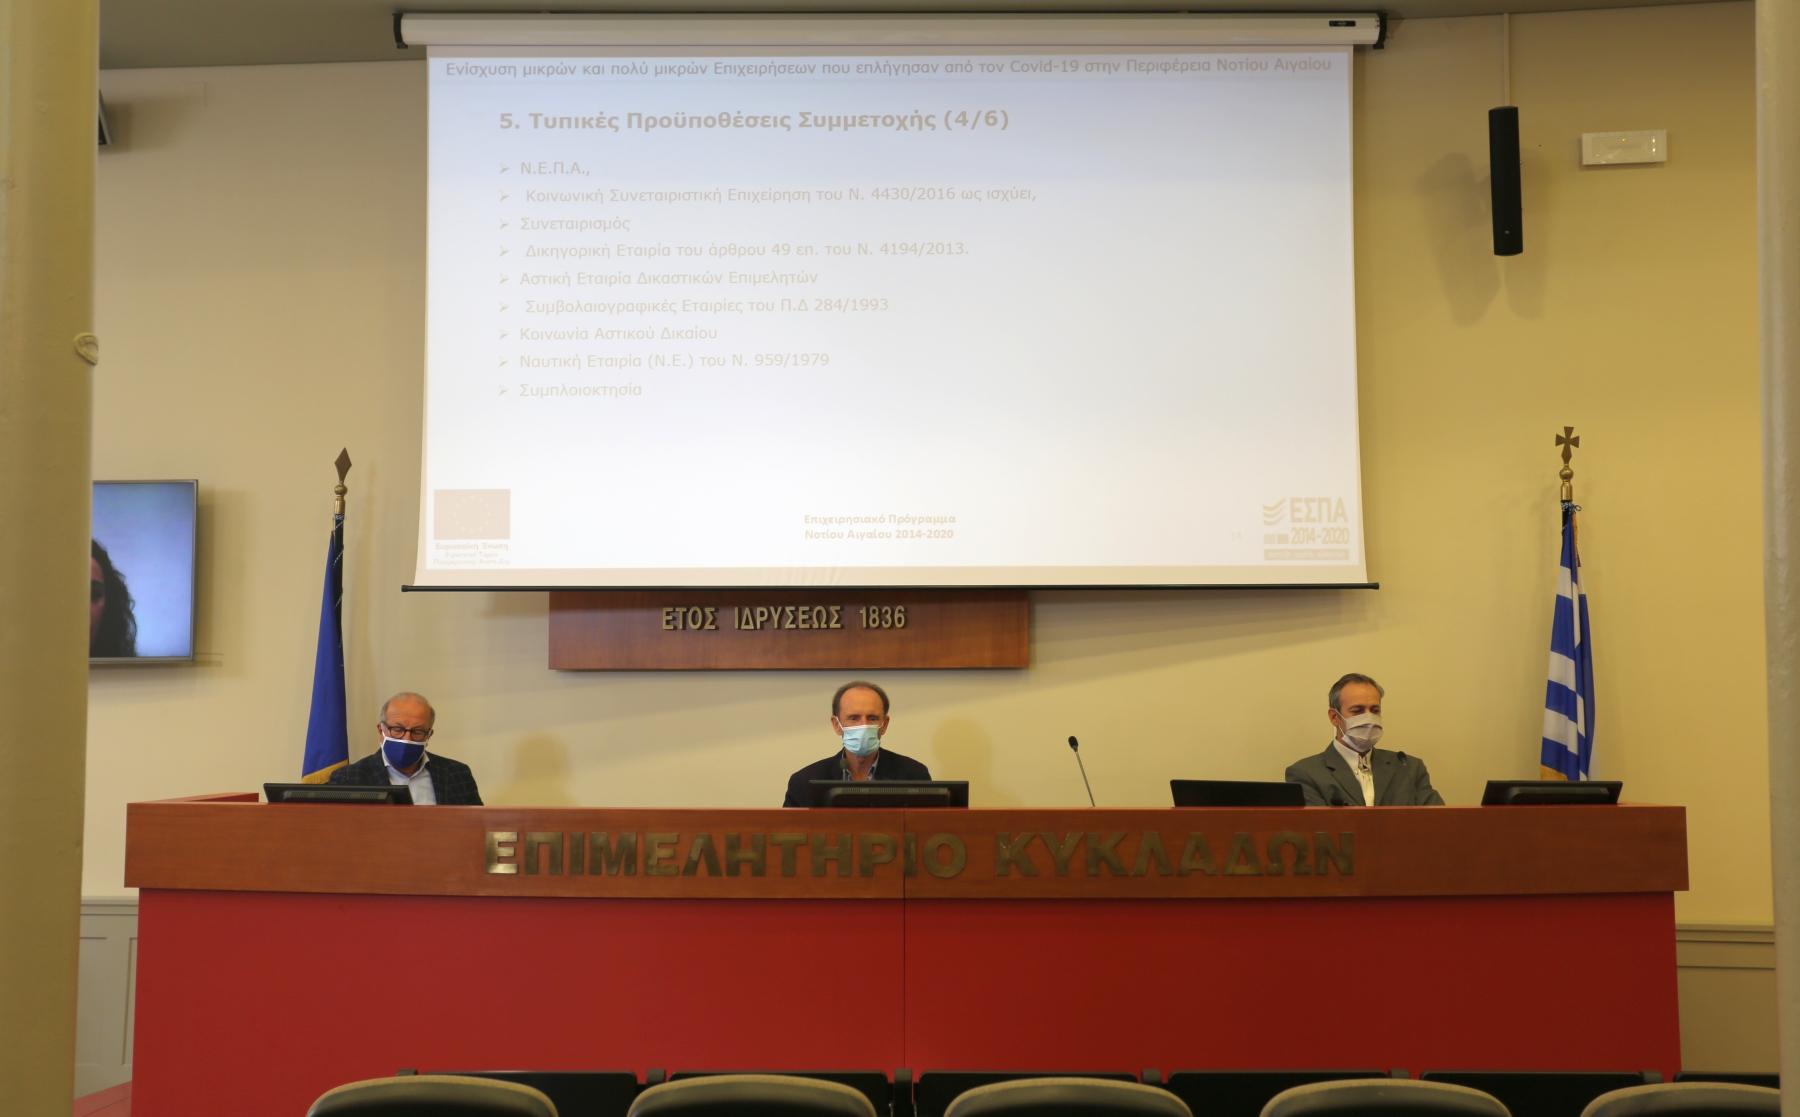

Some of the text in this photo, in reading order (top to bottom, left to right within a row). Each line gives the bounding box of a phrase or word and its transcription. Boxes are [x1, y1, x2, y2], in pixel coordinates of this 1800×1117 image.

[445, 58, 1332, 79] Ενίσχυση μικρών και πολύ μικρών Επιχειρήσεων που επλήγησαν από τον Covid-19 στην Περιφέρεια Νοτίου Αιγαίου
[528, 110, 619, 133] Τυπικές
[626, 110, 792, 133] Προϋποθέσεις
[798, 109, 937, 132] Συμμετοχής
[943, 109, 1010, 132] (4/6)
[525, 188, 604, 206] Κοινωνική
[609, 187, 722, 205] Συνεταιριστική
[727, 187, 811, 204] Επιχείρηση
[815, 190, 844, 201] του
[870, 186, 956, 202] 4430/2016
[961, 189, 982, 203] ως
[520, 215, 631, 233] Συνεταιρισμός
[525, 242, 611, 260] Δικηγορική
[615, 242, 671, 260] Εταιρία
[676, 245, 703, 257] του
[708, 242, 767, 259] άρθρου
[771, 242, 792, 257] 49
[824, 244, 852, 257] του
[519, 269, 818, 289] Αστική Εταιρία Δικαστικών Επιμελητών
[525, 298, 677, 316] Συμβολαιογραφικές
[681, 297, 744, 315] Εταιρίες
[748, 300, 775, 313] του
[813, 297, 890, 314] 284/1993
[519, 324, 718, 343] Κοινωνία Αστικού Δικαίου
[519, 352, 582, 371] Ναυτική
[586, 353, 642, 371] Εταιρία
[699, 355, 727, 368] του
[754, 352, 830, 369] 959/1979
[519, 381, 643, 399] Συμπλοιοκτησία
[804, 514, 956, 525] Επιχειρησιακό Πρόγραμμα
[1290, 497, 1348, 523] ΕΣΠΑ
[805, 528, 954, 541] Νοτίου Αιγαίου 2014-2020
[1291, 527, 1349, 544] 2014-2020
[663, 606, 906, 630] ΕΤΟΣ ΙΔΡΥΣΕΩΣ 1836
[486, 831, 1354, 878] ΕΠΙΜΕΛΗΤΗΡΙΟ ΚΥΚΛΑΔΩΝ
